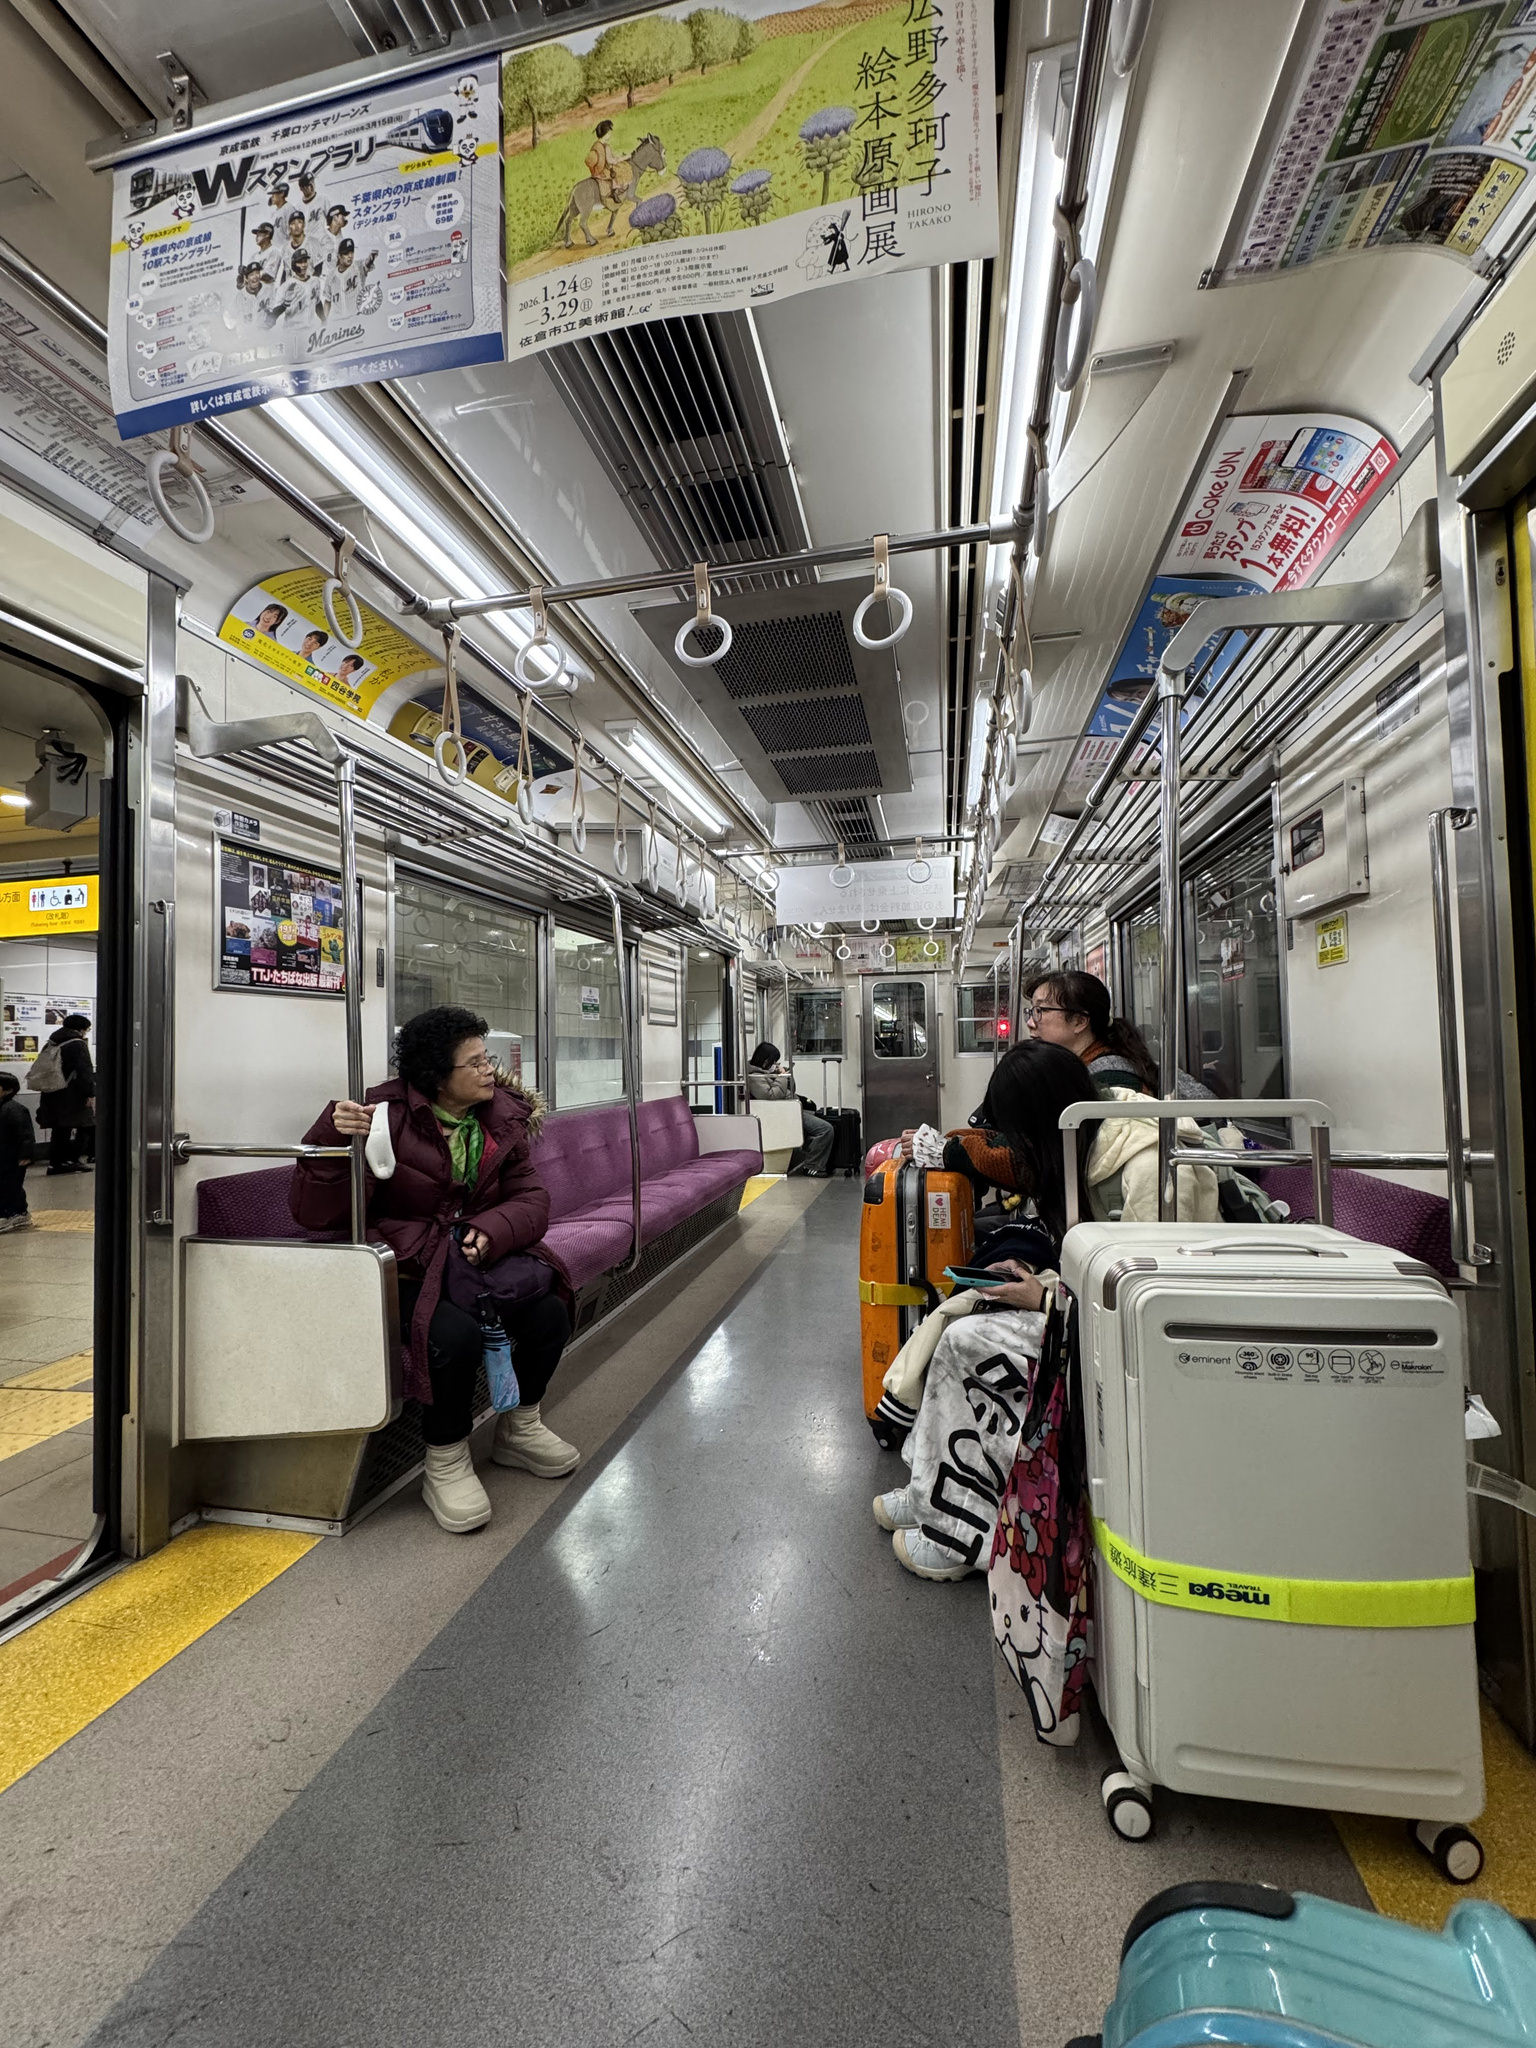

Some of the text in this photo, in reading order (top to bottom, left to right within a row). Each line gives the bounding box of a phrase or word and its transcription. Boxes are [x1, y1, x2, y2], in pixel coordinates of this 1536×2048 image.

[219, 103, 371, 156] 京成電鉄 千葉ロッテマリーンズ
[404, 159, 433, 171] デジタルで
[853, 45, 905, 266] 絵本原画展
[353, 196, 421, 219] スタンプラリー
[435, 215, 454, 224] 69駅
[907, 202, 952, 219] HIRONO
[907, 214, 952, 231] TAKAKO
[142, 231, 212, 260] 千葉県内の京成線
[142, 244, 221, 271] 10駅スタンプラリー
[541, 275, 578, 302] 1.24
[306, 323, 365, 355] Marines
[1192, 474, 1232, 524] Coke
[1201, 530, 1229, 560] 買うたび
[1219, 517, 1257, 562] スタンプ
[329, 680, 361, 704] 四谷学院
[319, 973, 341, 990] 最新刊
[1192, 1355, 1231, 1365] eminent
[1188, 1582, 1270, 1606] mega
